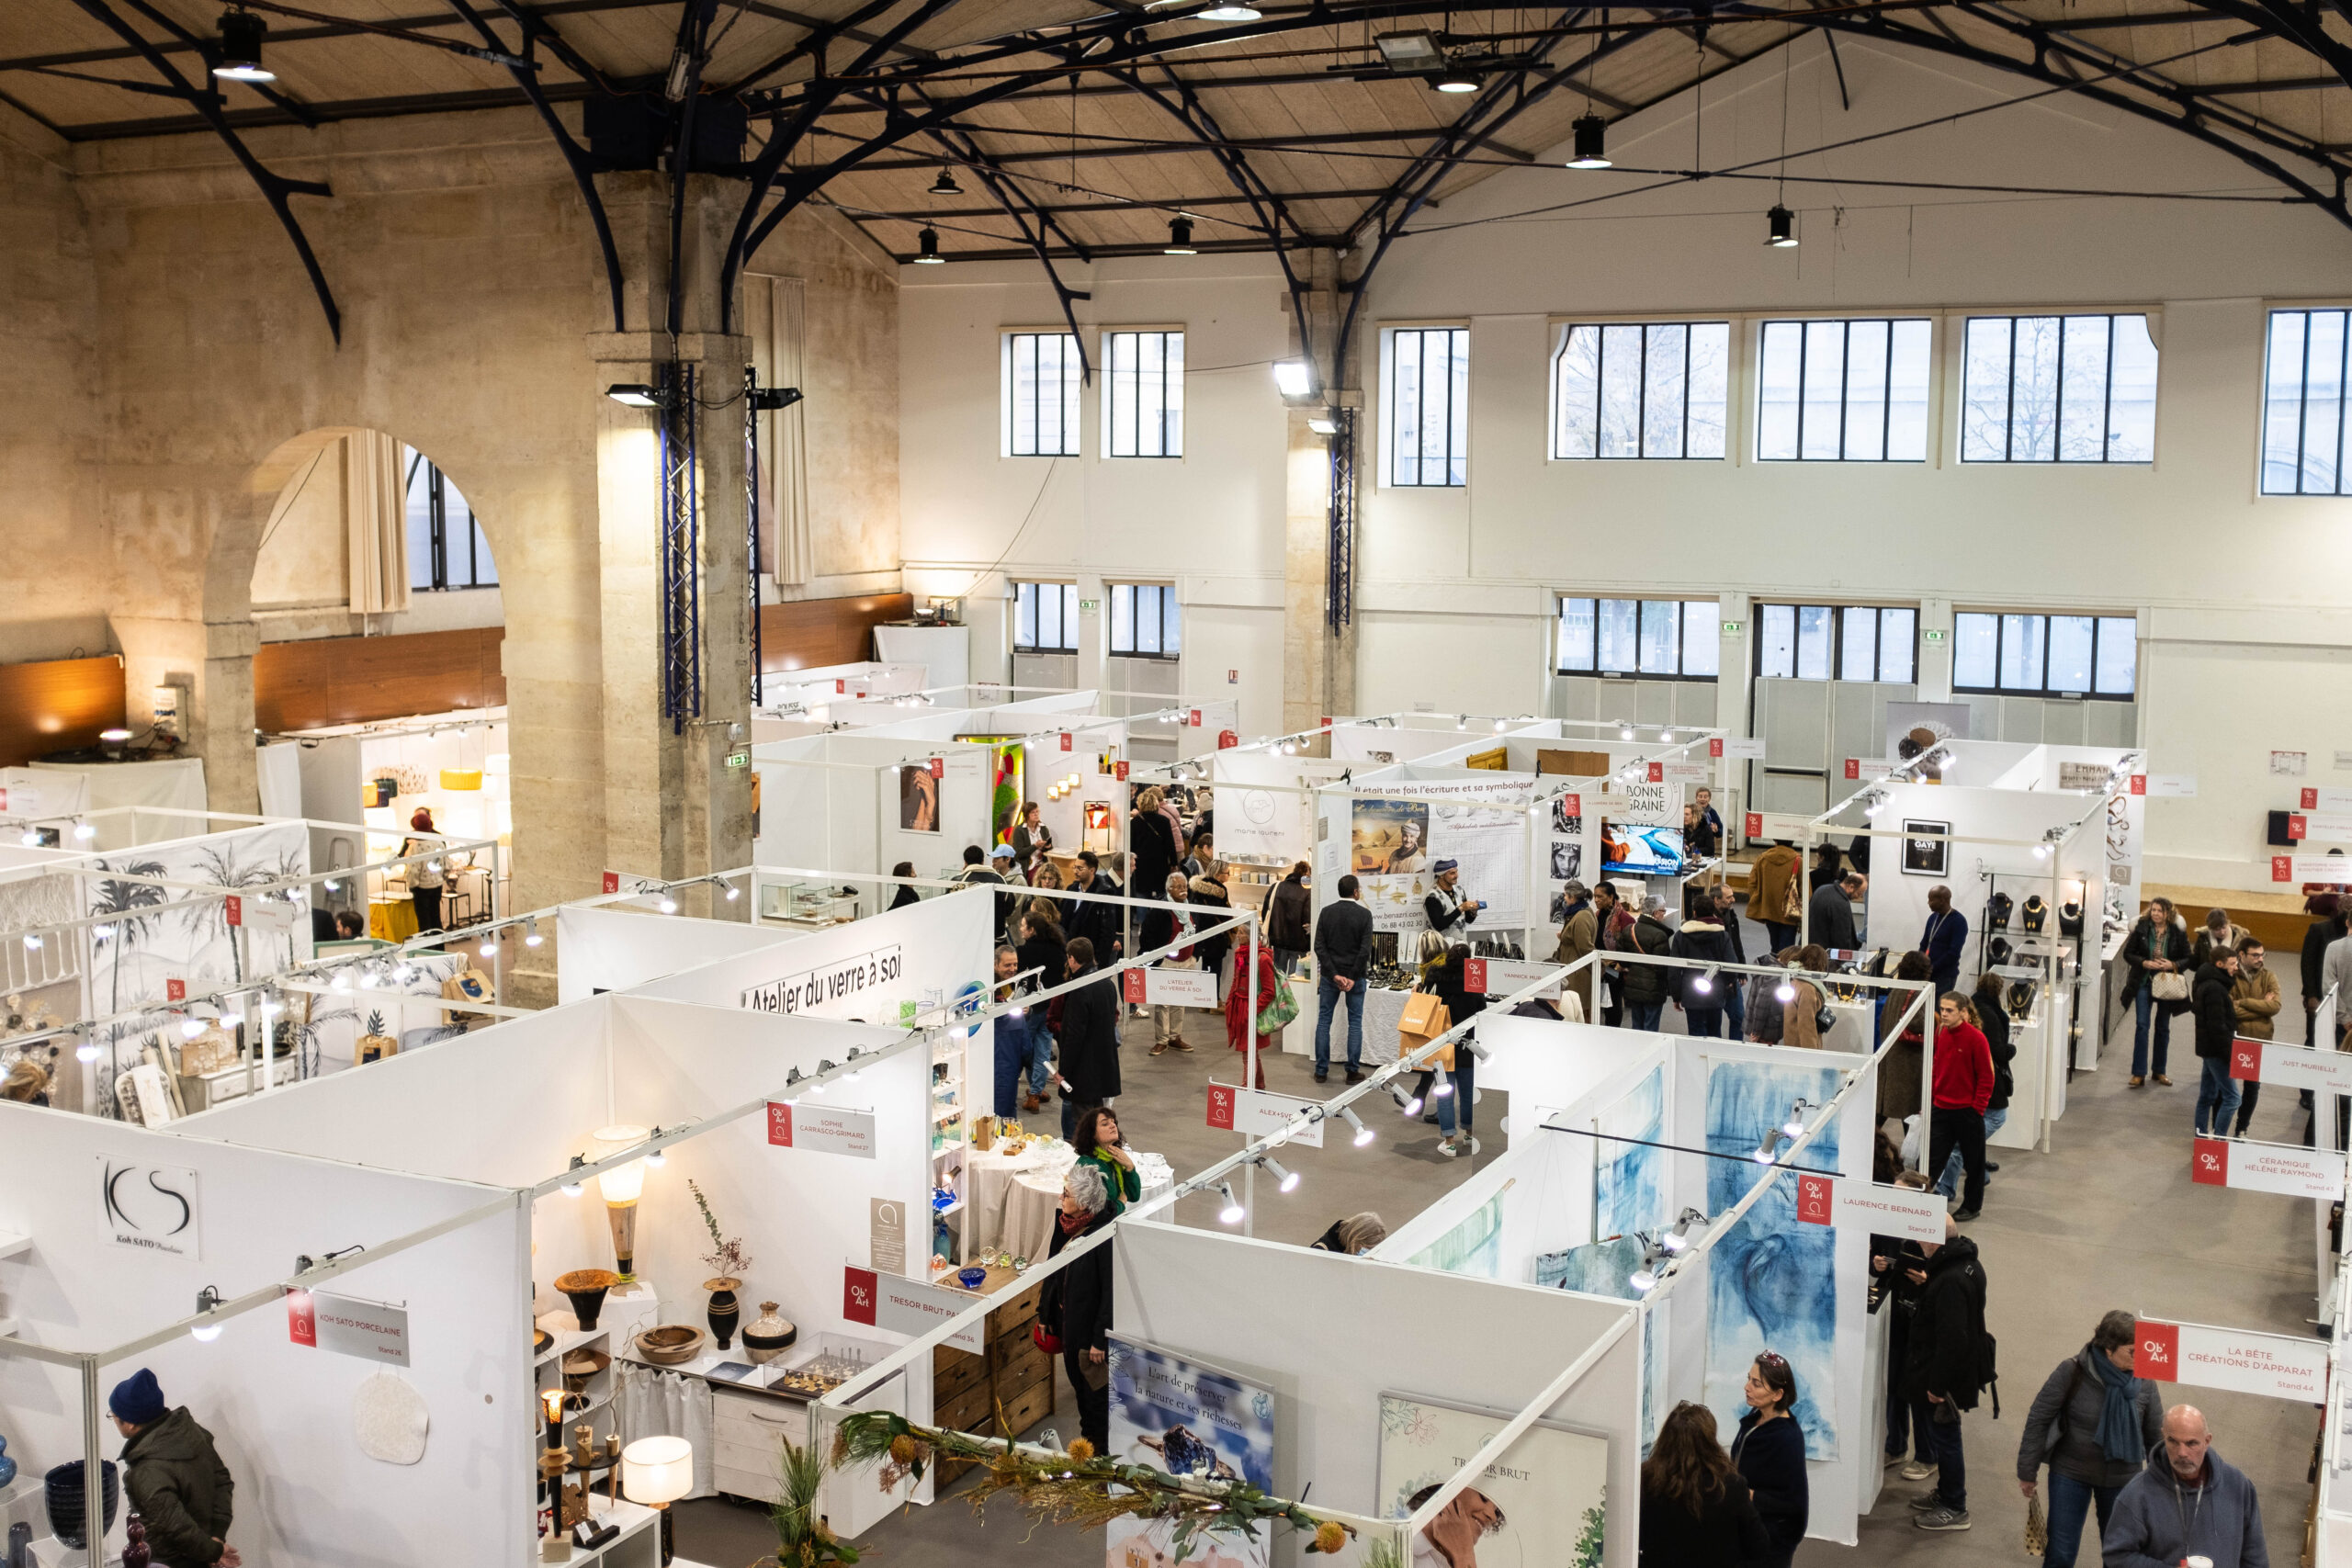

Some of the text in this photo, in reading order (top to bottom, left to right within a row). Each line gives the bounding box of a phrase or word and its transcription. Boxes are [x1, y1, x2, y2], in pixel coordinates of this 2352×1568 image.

[2075, 765, 2109, 773] EMMAN
[1403, 785, 1419, 795] fois
[1420, 784, 1460, 794] l'écriture
[1486, 781, 1533, 793] symbolique
[1627, 784, 1666, 799] BONNE
[1373, 911, 1423, 919] ww.benazri.com
[806, 972, 824, 1009] du
[829, 964, 865, 1000] verre
[868, 953, 876, 987] à
[881, 945, 901, 984] soi
[2237, 1053, 2253, 1062] Ob'
[2241, 1060, 2255, 1069] Art
[2281, 1059, 2337, 1073] JUST MURIELLE
[1214, 1090, 1227, 1100] Ob'
[1216, 1098, 1227, 1107] Art
[772, 1108, 784, 1117] Ob'
[775, 1115, 786, 1124] Art
[820, 1119, 843, 1128] SOPHIE
[799, 1124, 865, 1140] CARRASCO-GRIMARD
[2200, 1152, 2219, 1164] Ob'
[2259, 1156, 2311, 1169] CÉRAMIQUE
[2205, 1162, 2221, 1172] Art
[2280, 1168, 2325, 1179] RAYMOND
[1805, 1181, 1822, 1192] Ob'
[2305, 1183, 2324, 1191] Stand
[1809, 1190, 1823, 1201] Art
[1843, 1197, 1933, 1218] LAURENCE BERNARD
[1907, 1224, 1928, 1235] Stand
[116, 1234, 131, 1244] Koh
[133, 1237, 154, 1248] SATO
[851, 1285, 867, 1298] Ob'
[855, 1295, 869, 1308] Art
[889, 1294, 960, 1318] TRESOR BRUT PA
[320, 1314, 401, 1337] KOH SATO PORCELAINE
[966, 1335, 975, 1344] 36
[2143, 1339, 2165, 1353] Ob'
[378, 1346, 394, 1355] Stand
[2228, 1347, 2273, 1360] LA BÊTE
[2150, 1351, 2168, 1364] Art
[2188, 1351, 2313, 1378] CRÉATIONS D'APPARAT
[1148, 1365, 1227, 1404] L'art de préserver
[2277, 1380, 2314, 1393] Stand 44
[1135, 1381, 1243, 1431] la nature et ses richesses
[1499, 1465, 1531, 1482] BRUT
